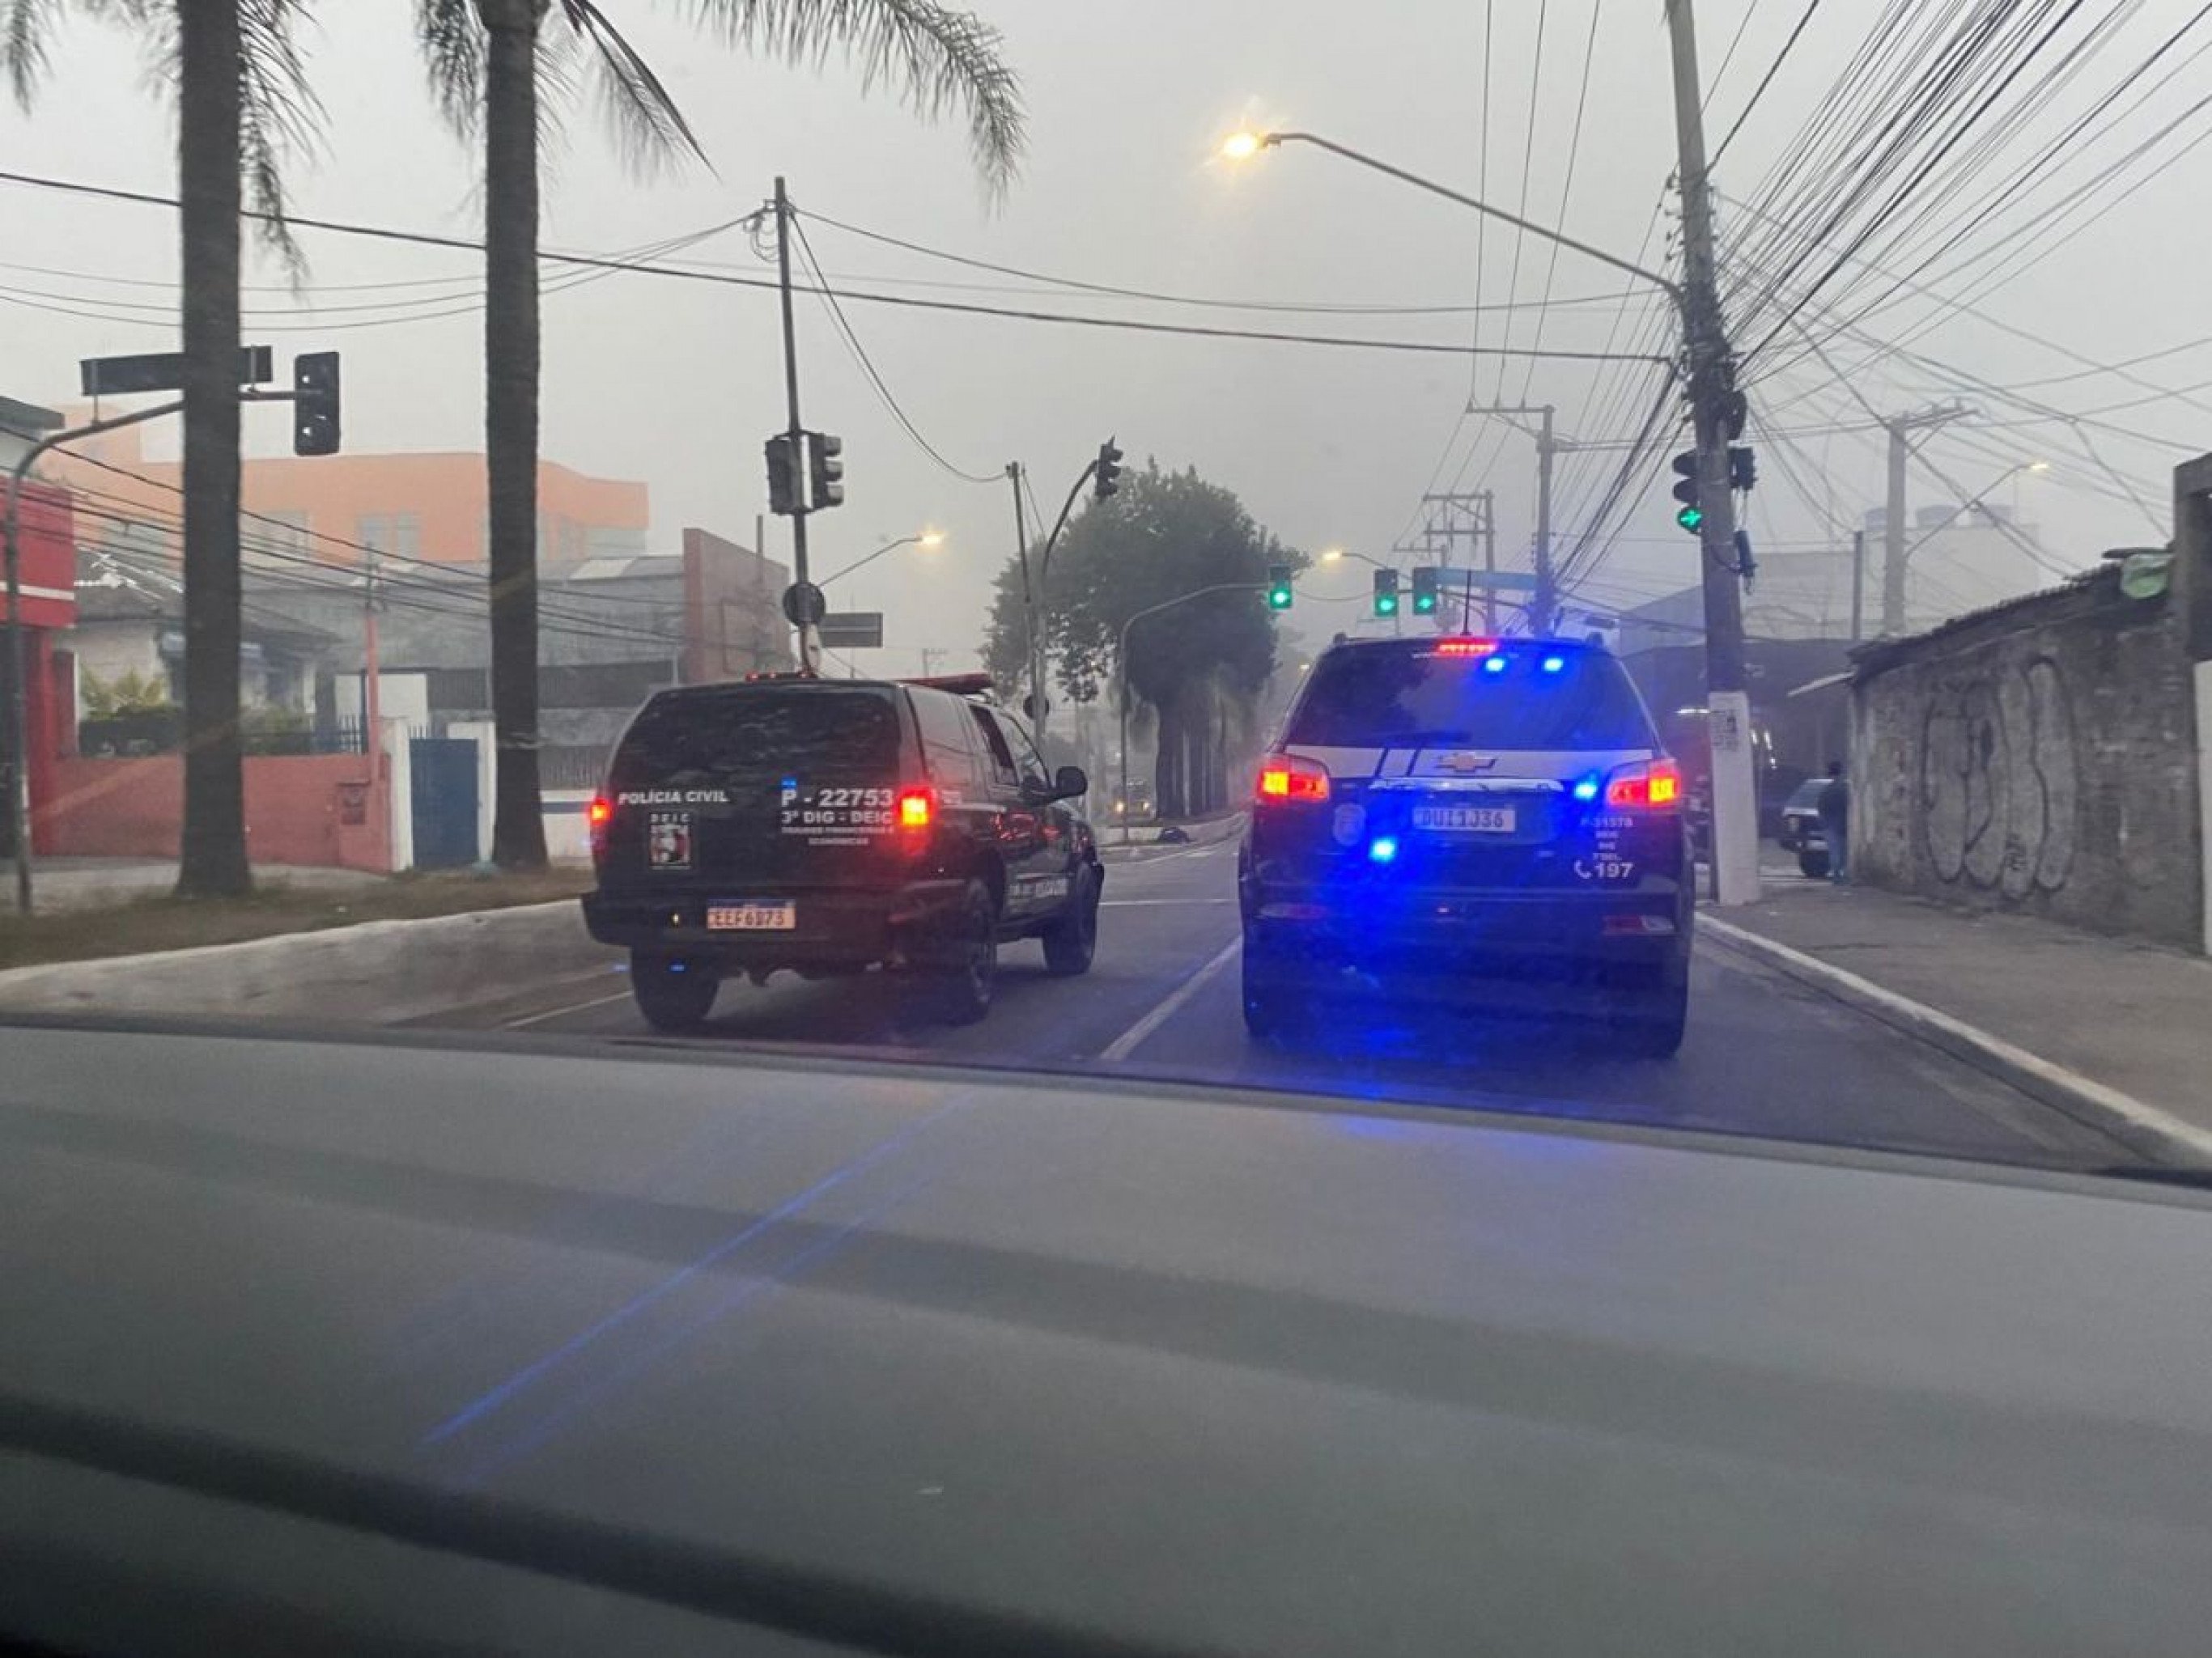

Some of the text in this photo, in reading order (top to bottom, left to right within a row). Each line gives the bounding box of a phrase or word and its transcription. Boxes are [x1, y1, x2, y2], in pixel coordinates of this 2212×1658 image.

[686, 790, 730, 803] CIVIL
[781, 789, 797, 808] P
[818, 787, 894, 808] 22753
[804, 811, 835, 825] DIG
[851, 810, 894, 824] DEIC
[1594, 862, 1634, 880] 197
